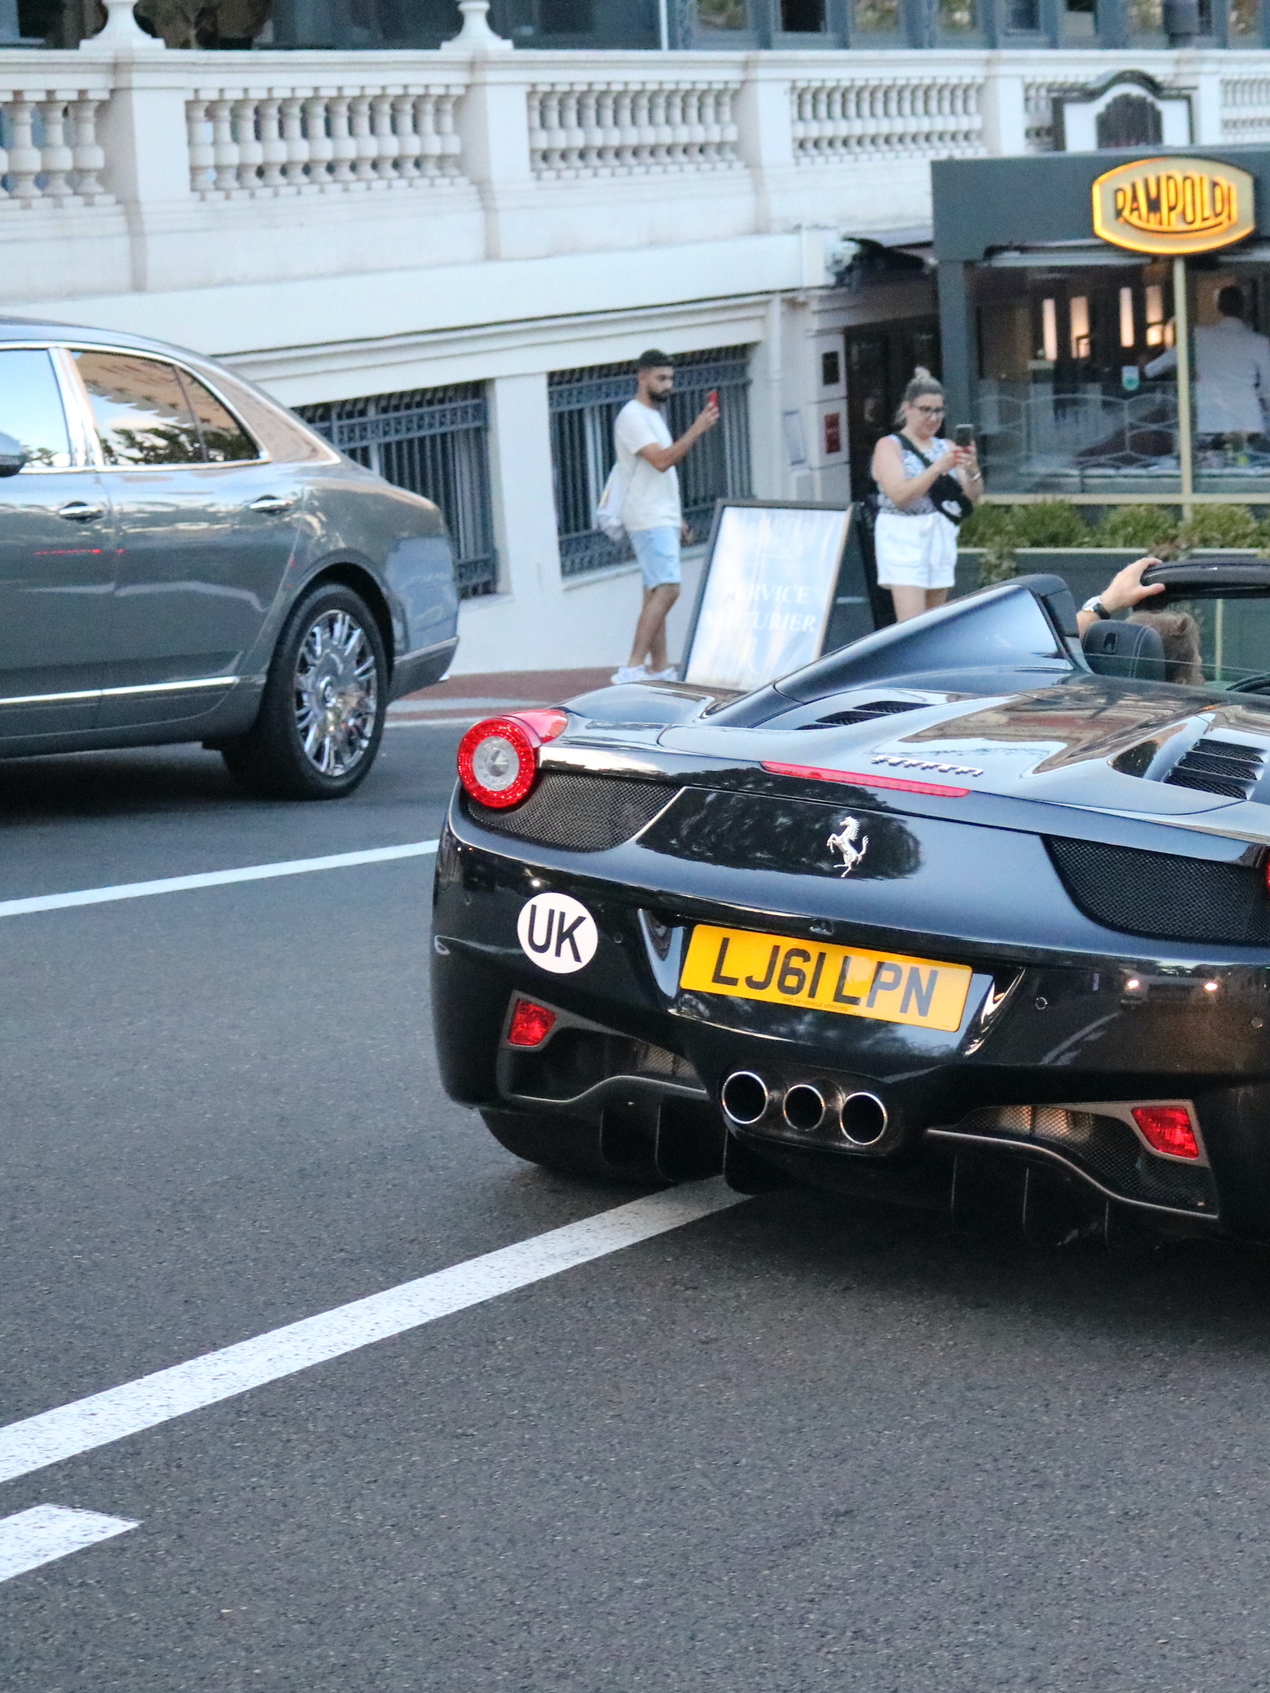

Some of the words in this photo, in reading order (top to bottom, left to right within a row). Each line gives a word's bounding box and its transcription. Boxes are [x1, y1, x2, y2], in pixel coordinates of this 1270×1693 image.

[1115, 171, 1239, 238] RAMPOLDI
[527, 903, 588, 964] UK
[711, 937, 827, 999] LJ61
[832, 955, 939, 1018] LPN
